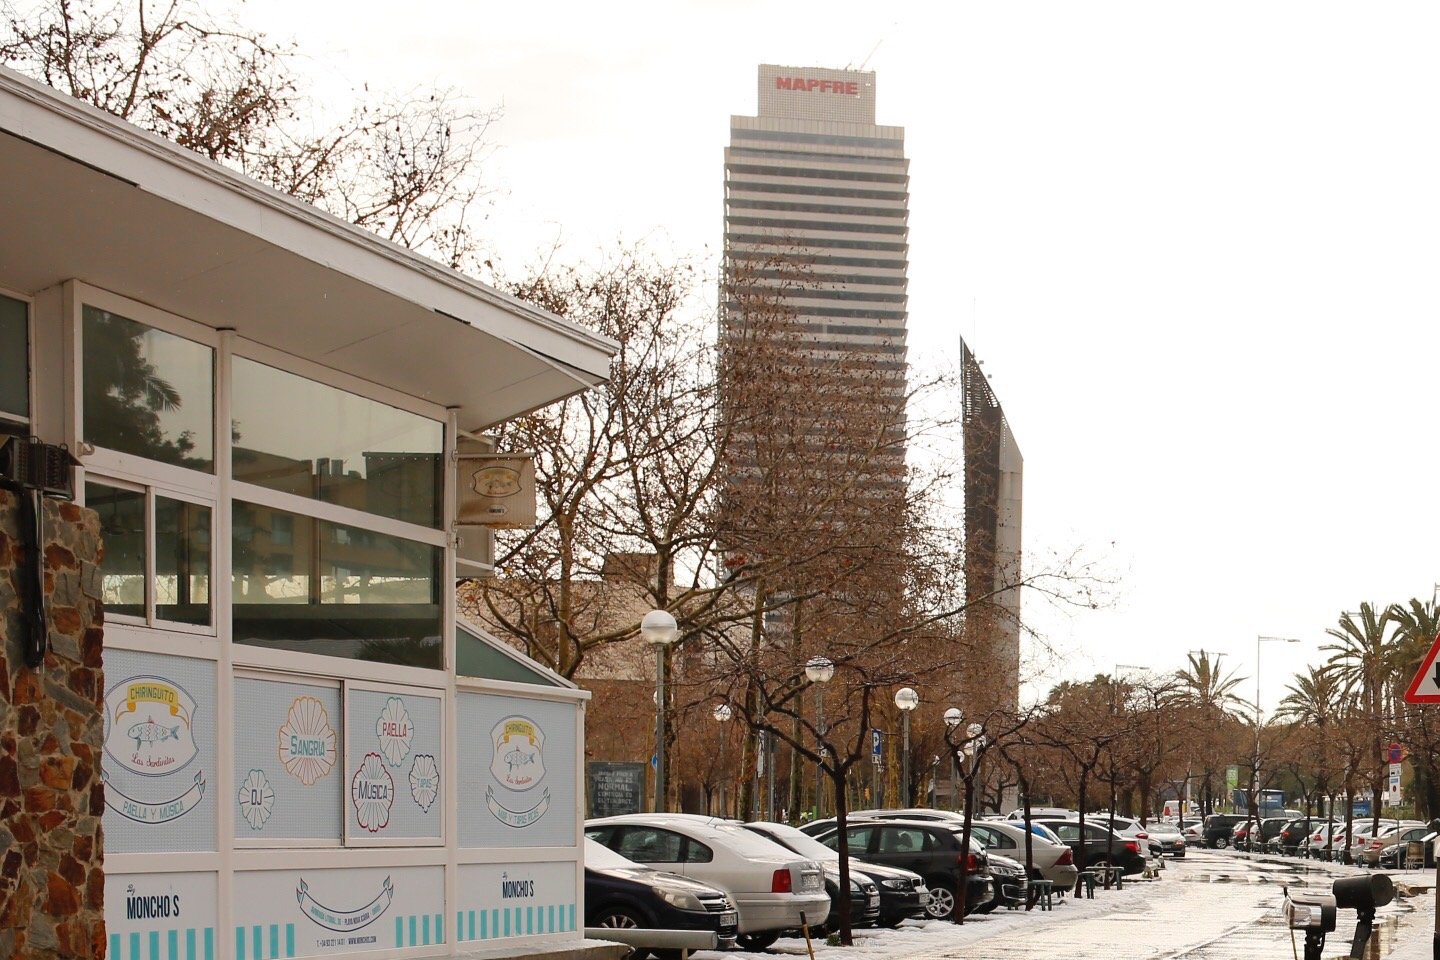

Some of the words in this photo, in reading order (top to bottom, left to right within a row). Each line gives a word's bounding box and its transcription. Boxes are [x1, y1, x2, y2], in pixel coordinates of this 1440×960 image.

[776, 77, 858, 95] MAPFRE
[130, 686, 174, 703] CHIRINGUITO
[382, 722, 407, 738] PAELLA
[131, 753, 144, 767] Las
[251, 788, 263, 806] DJ
[122, 800, 147, 820] PAELLA
[150, 808, 156, 820] Y
